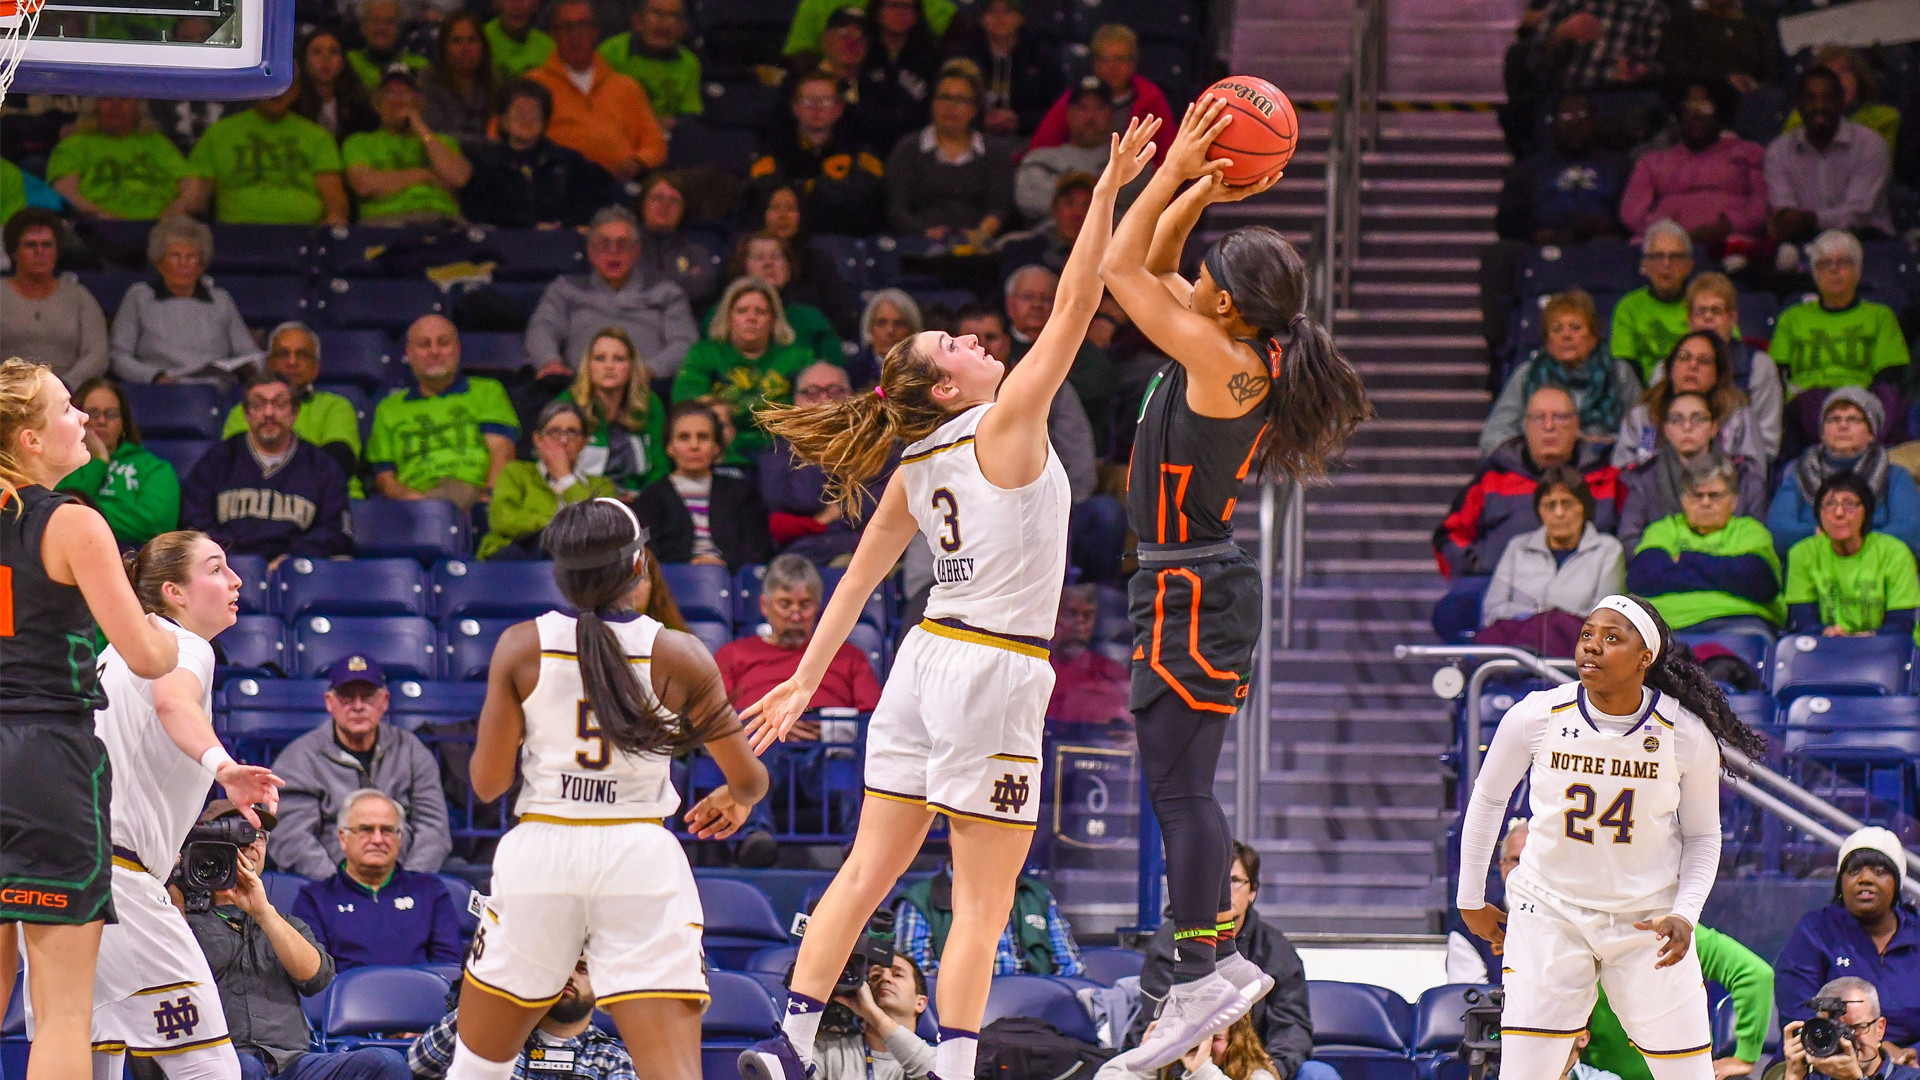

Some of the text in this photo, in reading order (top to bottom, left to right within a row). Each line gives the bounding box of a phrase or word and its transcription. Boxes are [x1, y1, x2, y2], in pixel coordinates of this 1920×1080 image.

[1213, 82, 1275, 118] Wilson
[932, 487, 962, 554] 3
[575, 699, 613, 771] 5
[561, 773, 618, 804] YOUNG
[1550, 751, 1659, 779] NOTRE DAME
[1564, 782, 1636, 845] 24
